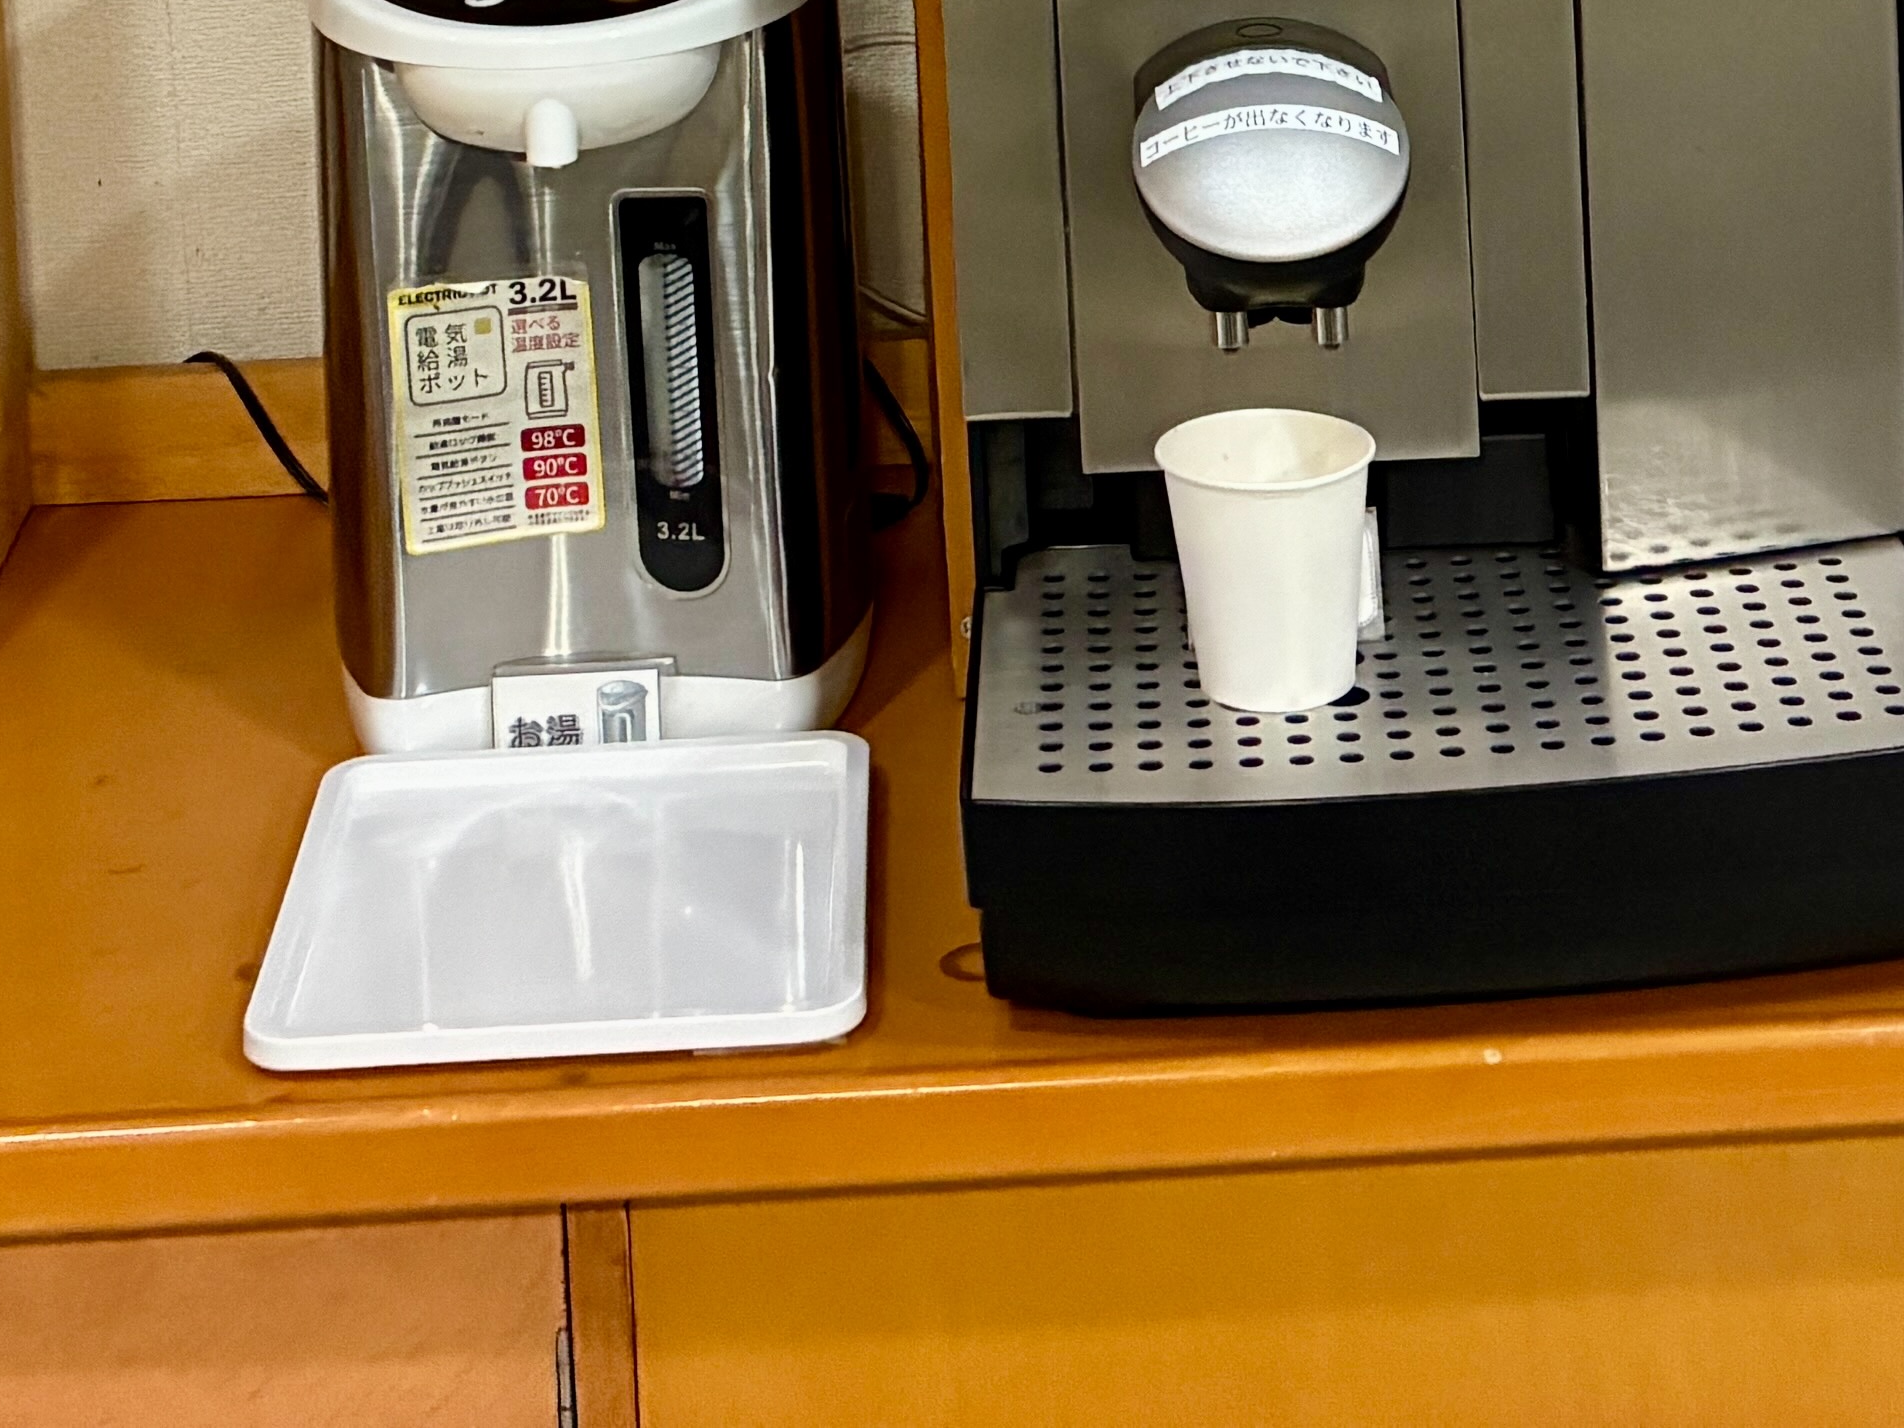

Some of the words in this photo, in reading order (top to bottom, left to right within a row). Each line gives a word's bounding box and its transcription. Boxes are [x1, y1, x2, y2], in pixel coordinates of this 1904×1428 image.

[1165, 54, 1374, 97] 上下させないで下さい
[1145, 107, 1393, 158] コーヒーが出なくなります
[508, 278, 577, 305] 3.2L
[416, 323, 468, 348] 電気
[511, 315, 561, 335] 選べる
[512, 332, 582, 354] 温度設定
[417, 346, 468, 373] 給湯
[420, 367, 489, 394] ポット
[657, 520, 706, 541] 3.2L
[508, 714, 584, 748] お湯
